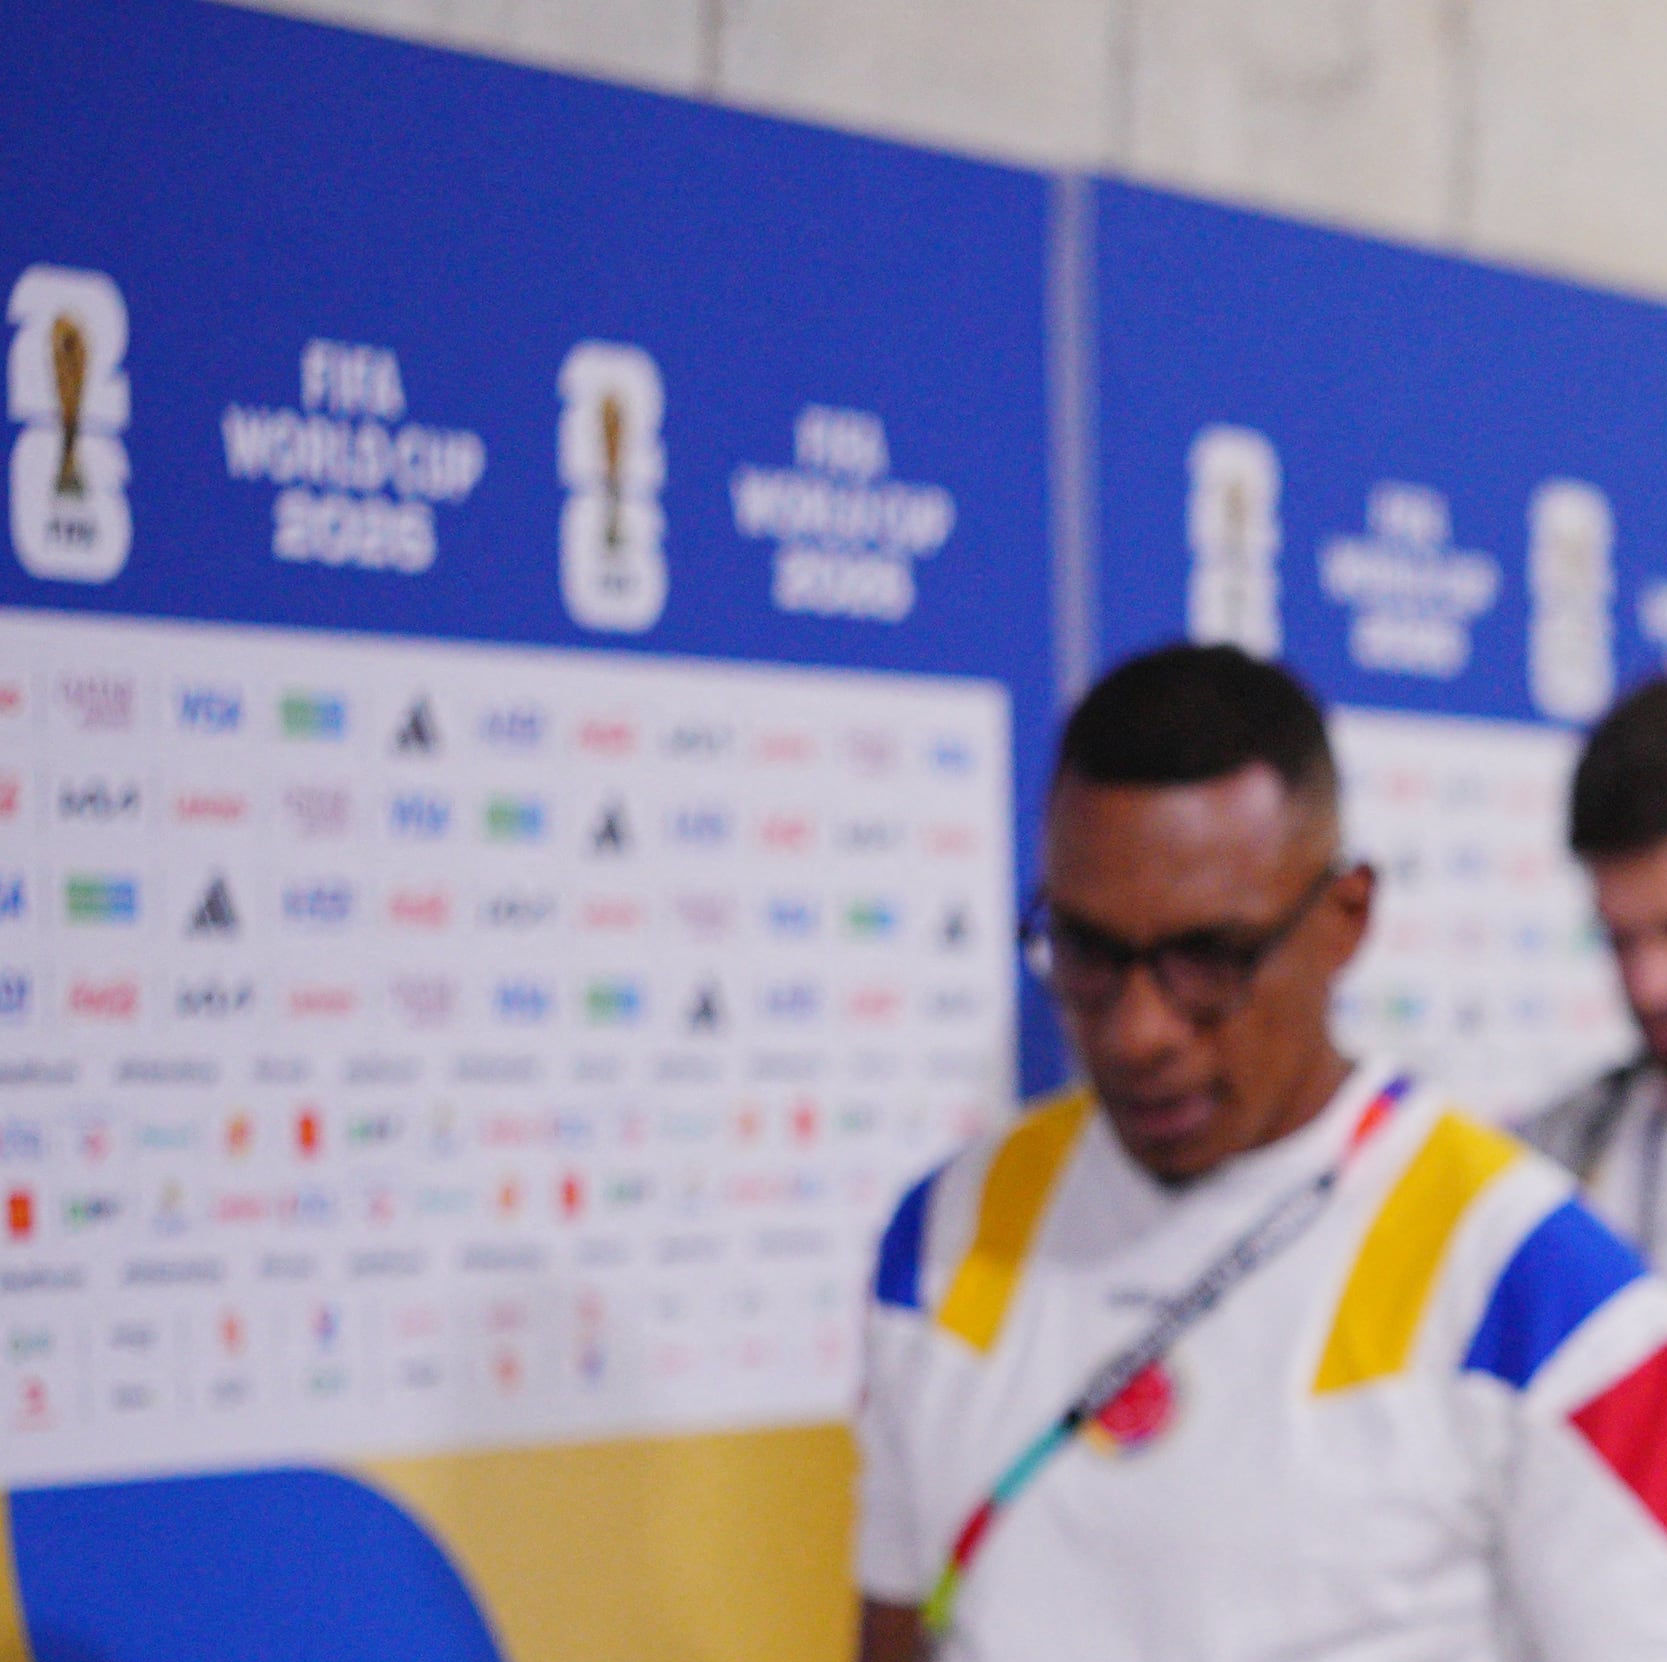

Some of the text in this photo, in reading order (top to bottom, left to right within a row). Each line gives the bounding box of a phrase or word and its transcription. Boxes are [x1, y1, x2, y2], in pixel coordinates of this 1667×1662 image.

[302, 338, 406, 421] FIFA
[221, 403, 486, 502] WORLD CUP
